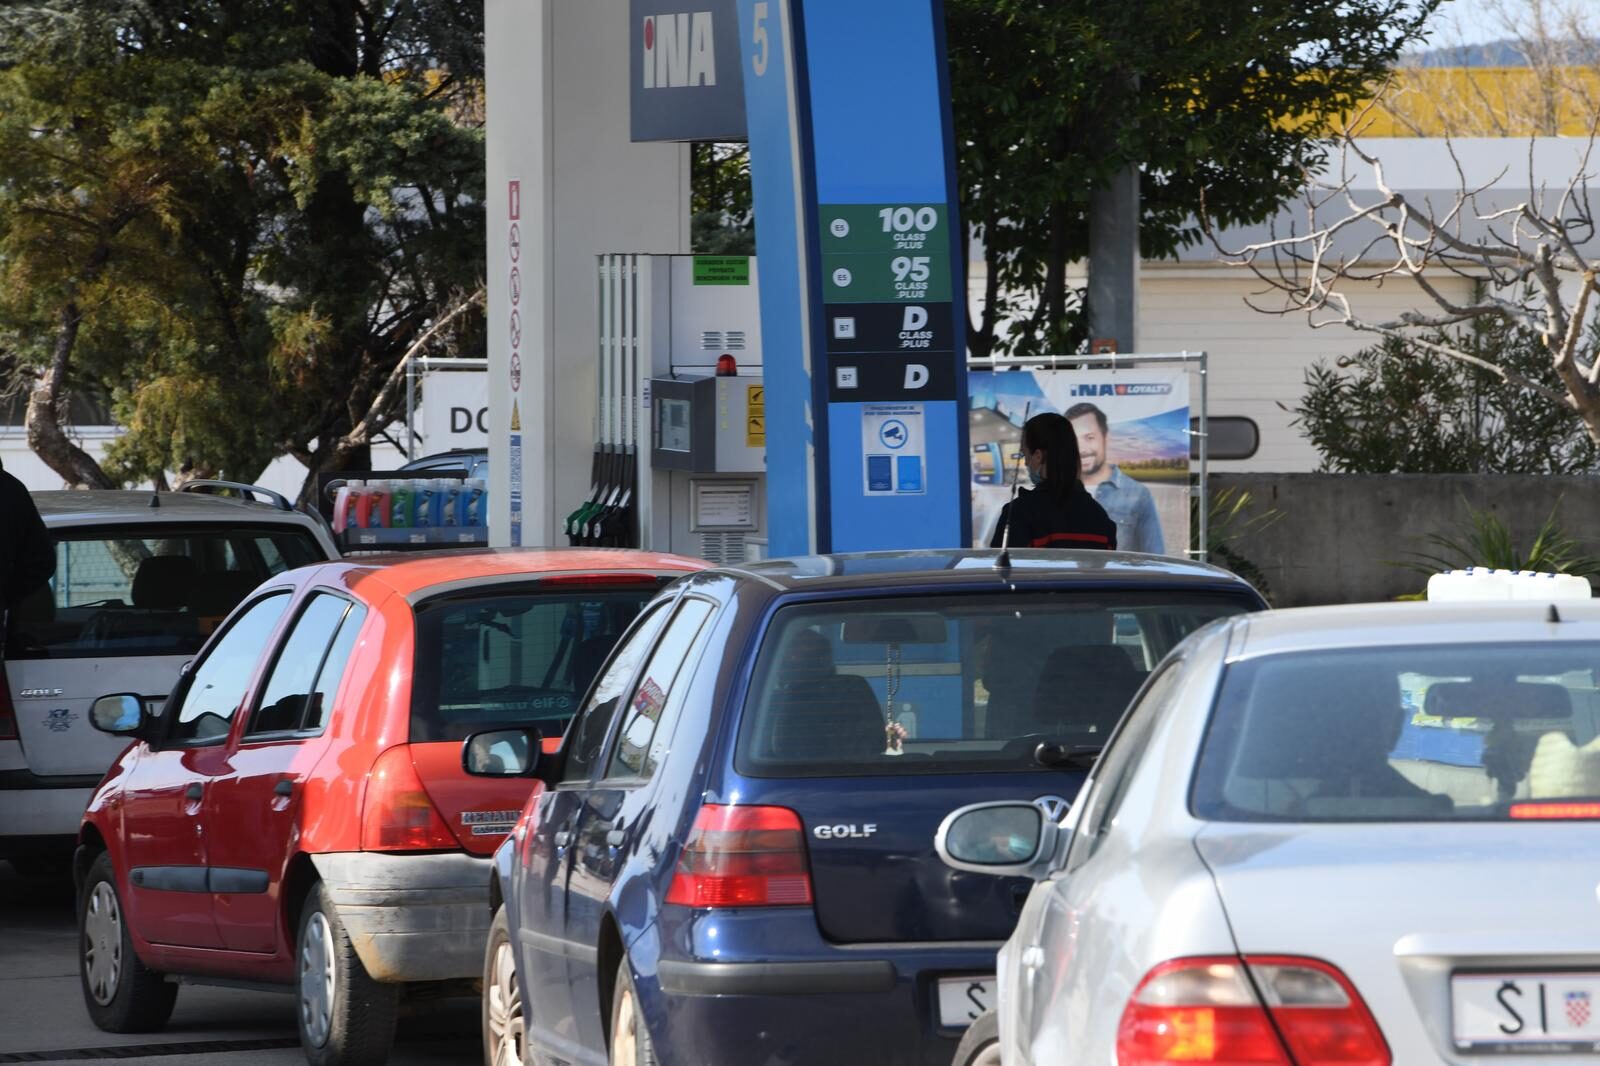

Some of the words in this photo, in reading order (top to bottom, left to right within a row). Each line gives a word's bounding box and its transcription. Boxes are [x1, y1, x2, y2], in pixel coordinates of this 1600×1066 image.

[752, 2, 769, 77] 5
[643, 11, 716, 89] INA
[878, 206, 938, 232] 100
[893, 233, 926, 241] CLASS
[891, 256, 931, 282] 95
[895, 282, 928, 290] CLASS
[898, 290, 925, 298] PLUS
[902, 305, 928, 331] D
[898, 331, 933, 339] CLASS
[901, 340, 930, 348] PLUS
[903, 364, 930, 389] D
[1127, 385, 1169, 393] LOYALTY
[813, 823, 878, 839] GOLF
[1496, 980, 1548, 1034] ŠI
